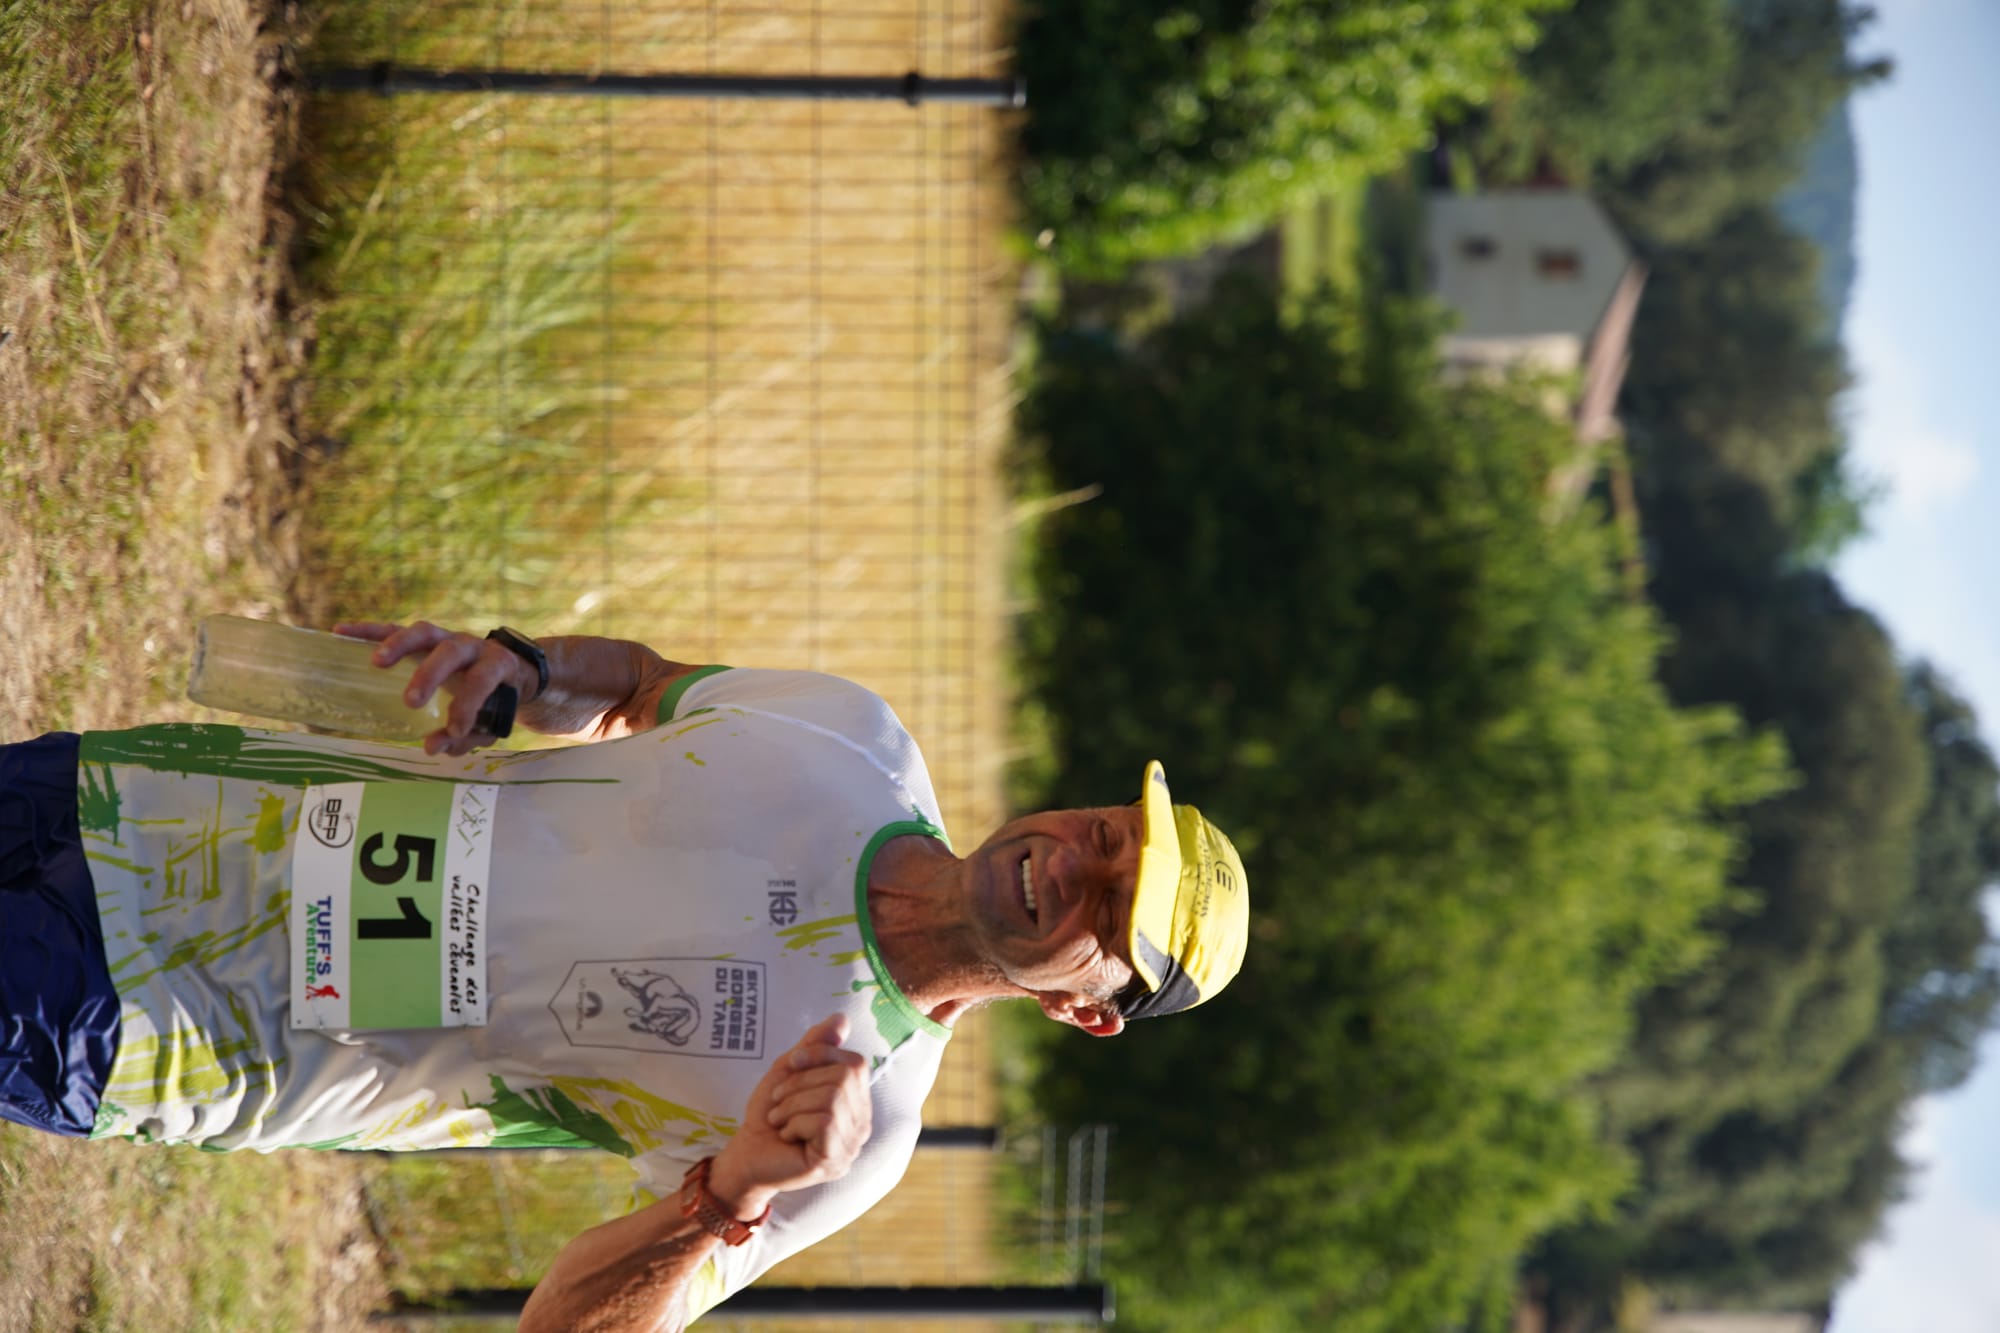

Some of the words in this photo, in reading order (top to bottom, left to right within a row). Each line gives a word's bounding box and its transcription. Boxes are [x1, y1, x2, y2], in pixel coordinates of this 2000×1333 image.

[324, 799, 342, 840] BFP
[358, 832, 436, 939] 51
[450, 876, 464, 931] vallées
[305, 904, 320, 985] Aventure
[317, 896, 332, 975] TUFF'S
[460, 884, 480, 968] Challenge
[449, 943, 464, 1014] cévenoles
[465, 978, 478, 1006] des
[715, 967, 728, 993] DU
[727, 968, 743, 1050] GORGES
[744, 969, 757, 1051] SKYRACE
[710, 1000, 726, 1050] TARN
